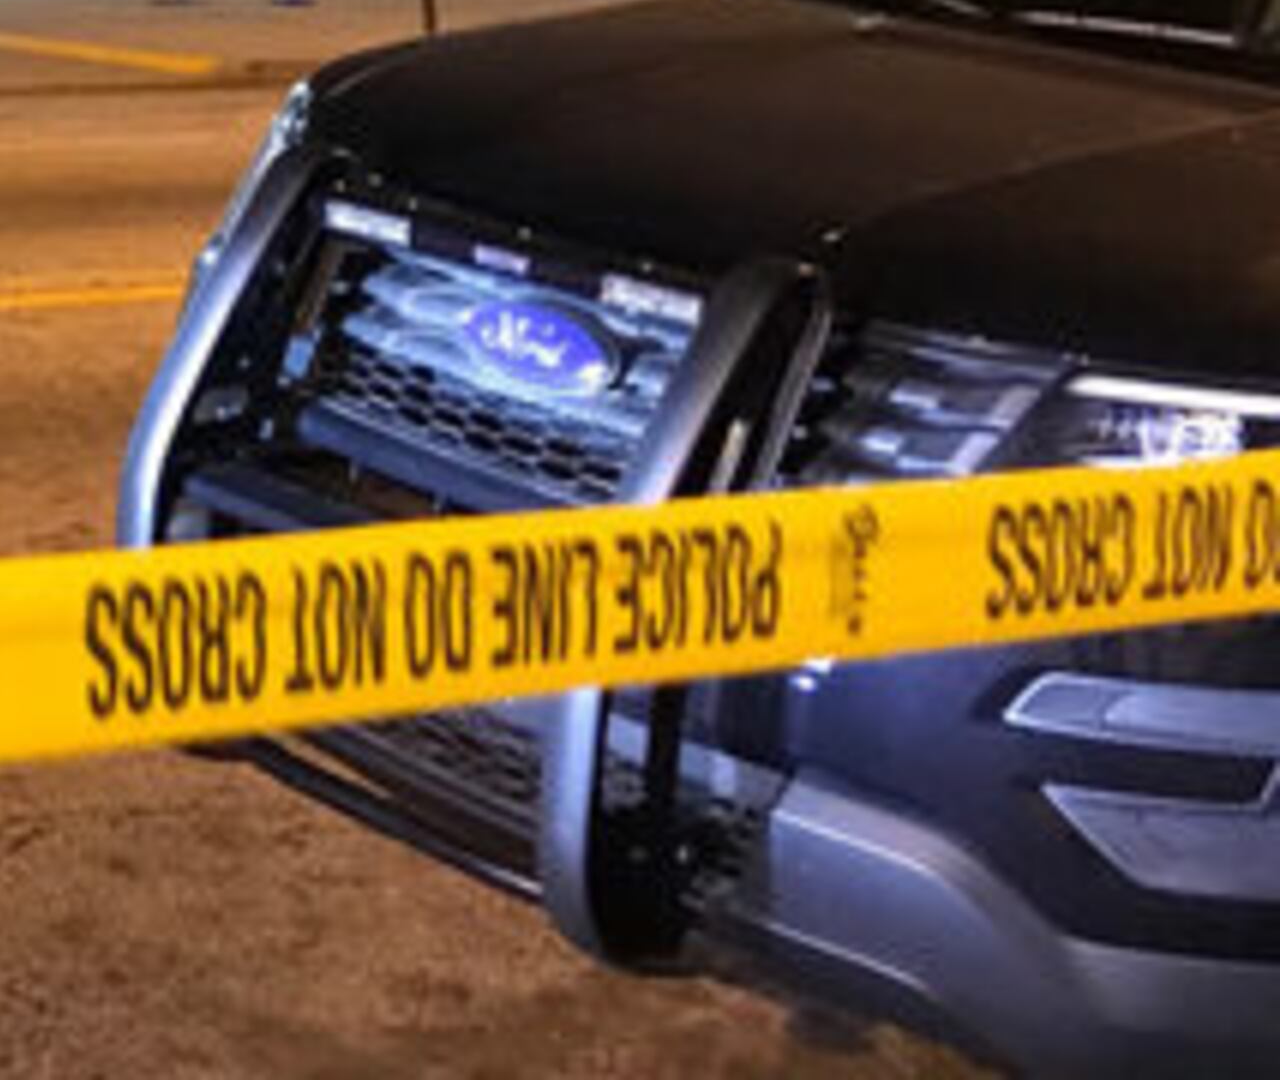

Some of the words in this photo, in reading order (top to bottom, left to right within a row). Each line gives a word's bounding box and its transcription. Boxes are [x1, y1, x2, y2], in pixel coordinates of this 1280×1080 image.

[490, 536, 603, 669] LINE
[612, 521, 784, 655] POLICE
[984, 491, 1137, 621] CROSS
[1141, 482, 1234, 600] NOT
[83, 568, 269, 721] CROSS
[284, 559, 388, 696] NOT
[402, 548, 475, 680] DO
